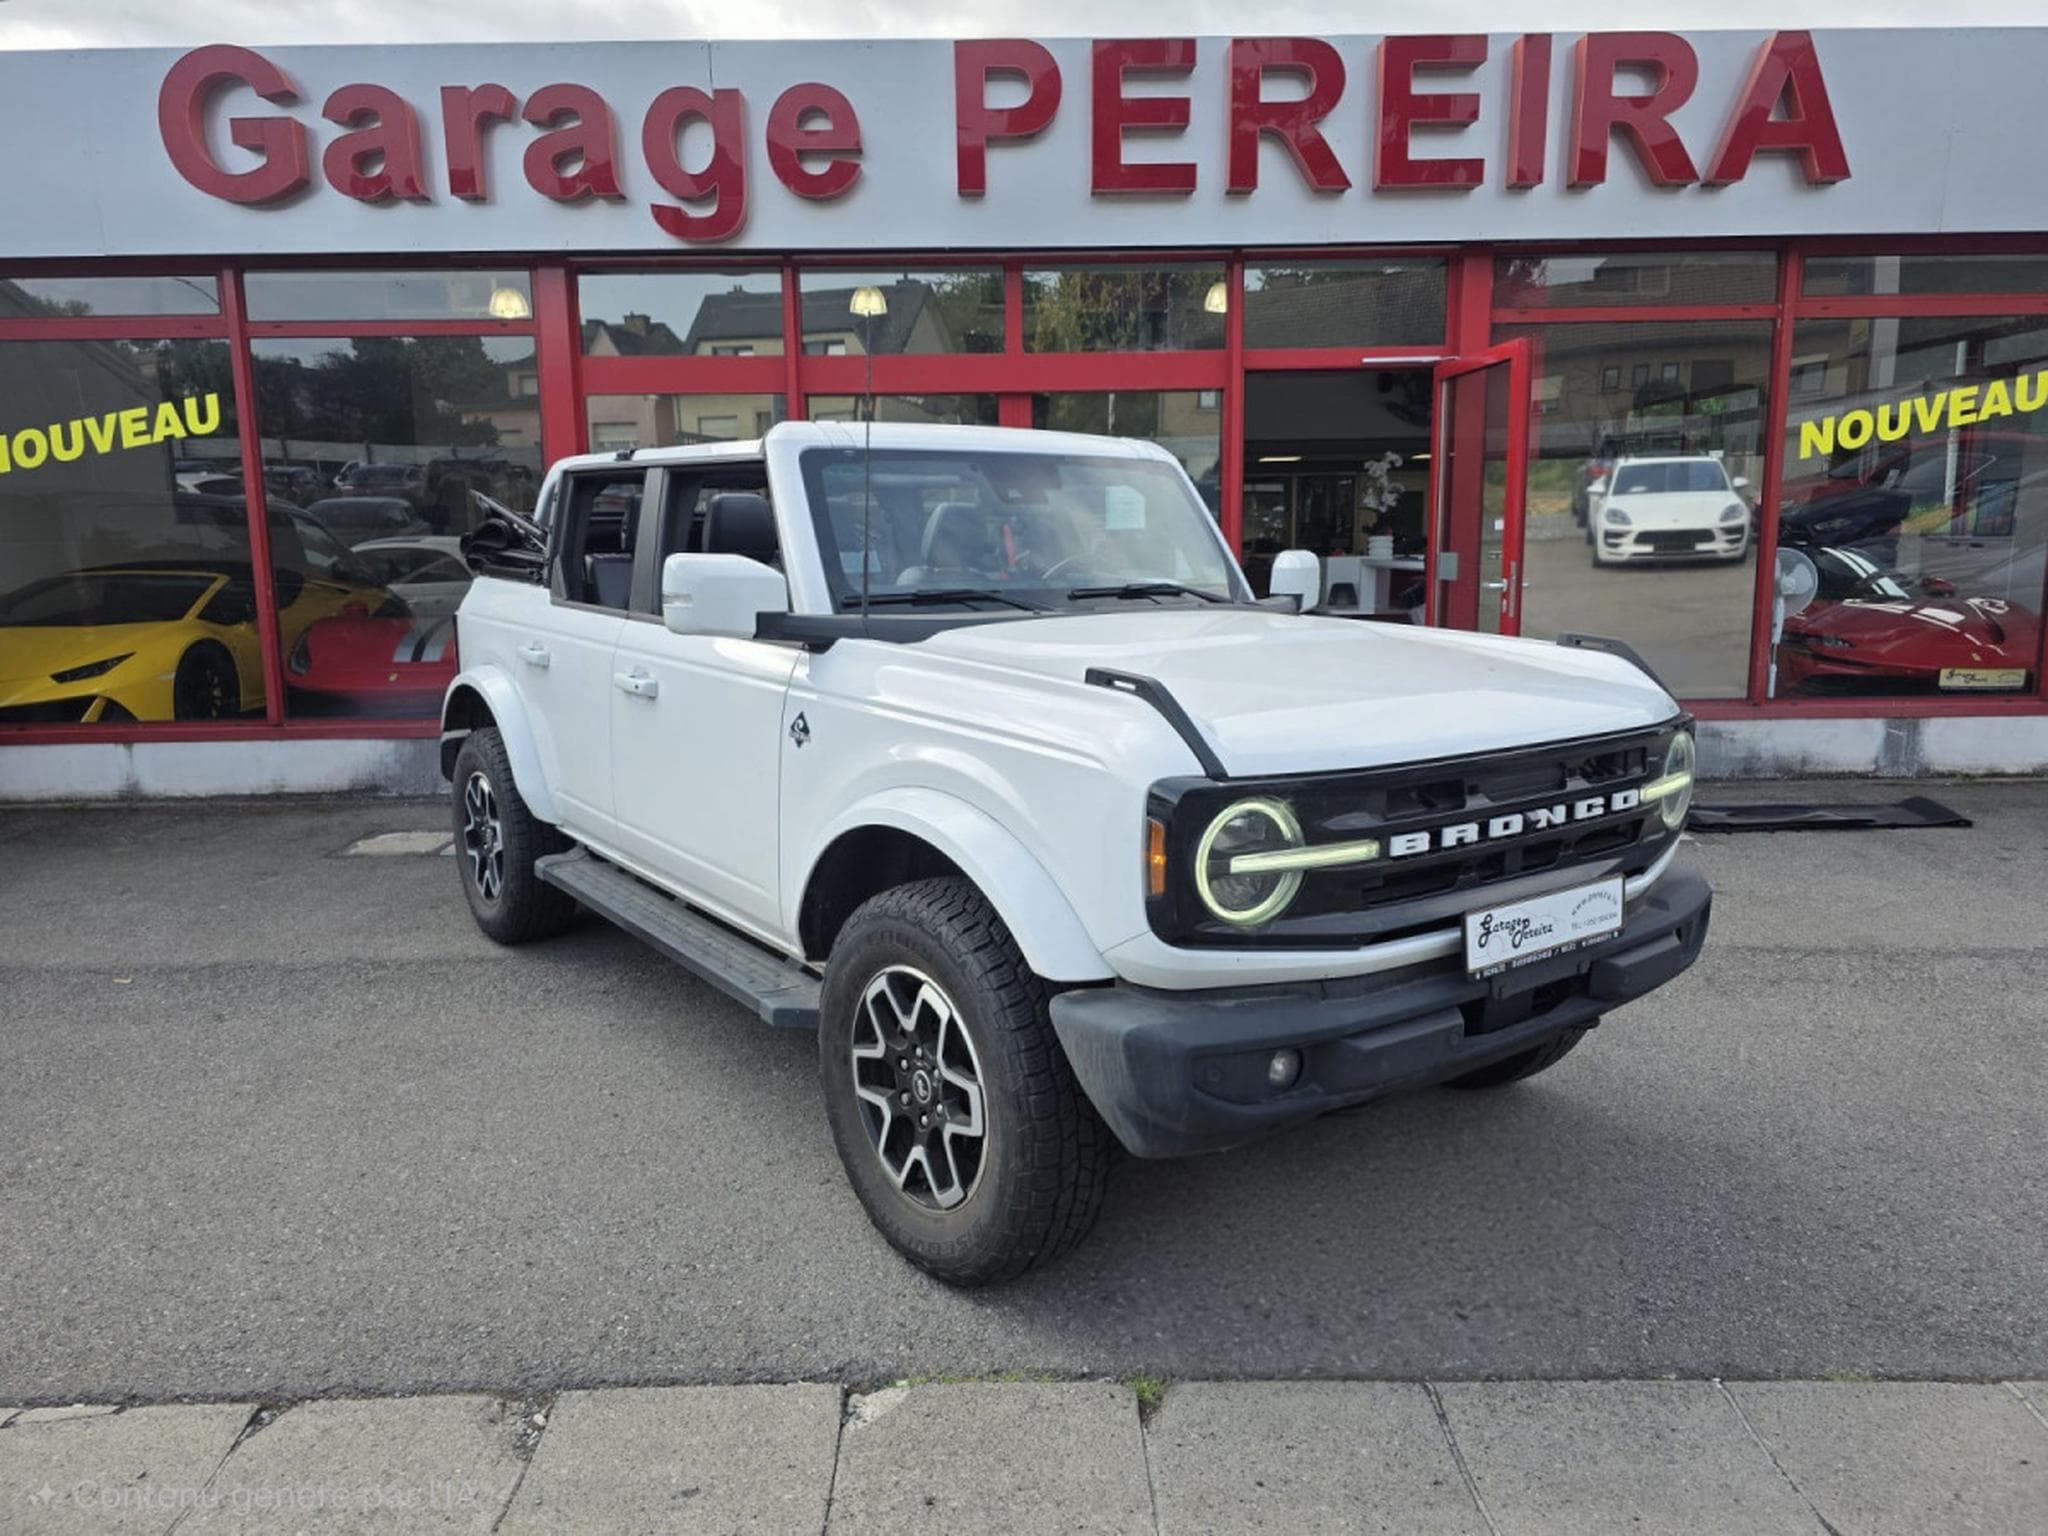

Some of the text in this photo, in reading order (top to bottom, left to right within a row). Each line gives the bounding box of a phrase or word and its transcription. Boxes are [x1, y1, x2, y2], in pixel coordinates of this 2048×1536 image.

[158, 30, 1851, 245] Garage PEREIRA
[1799, 369, 2048, 459] NOUVEAU
[1389, 789, 1640, 857] BRONCO
[1478, 913, 1522, 948] Garage
